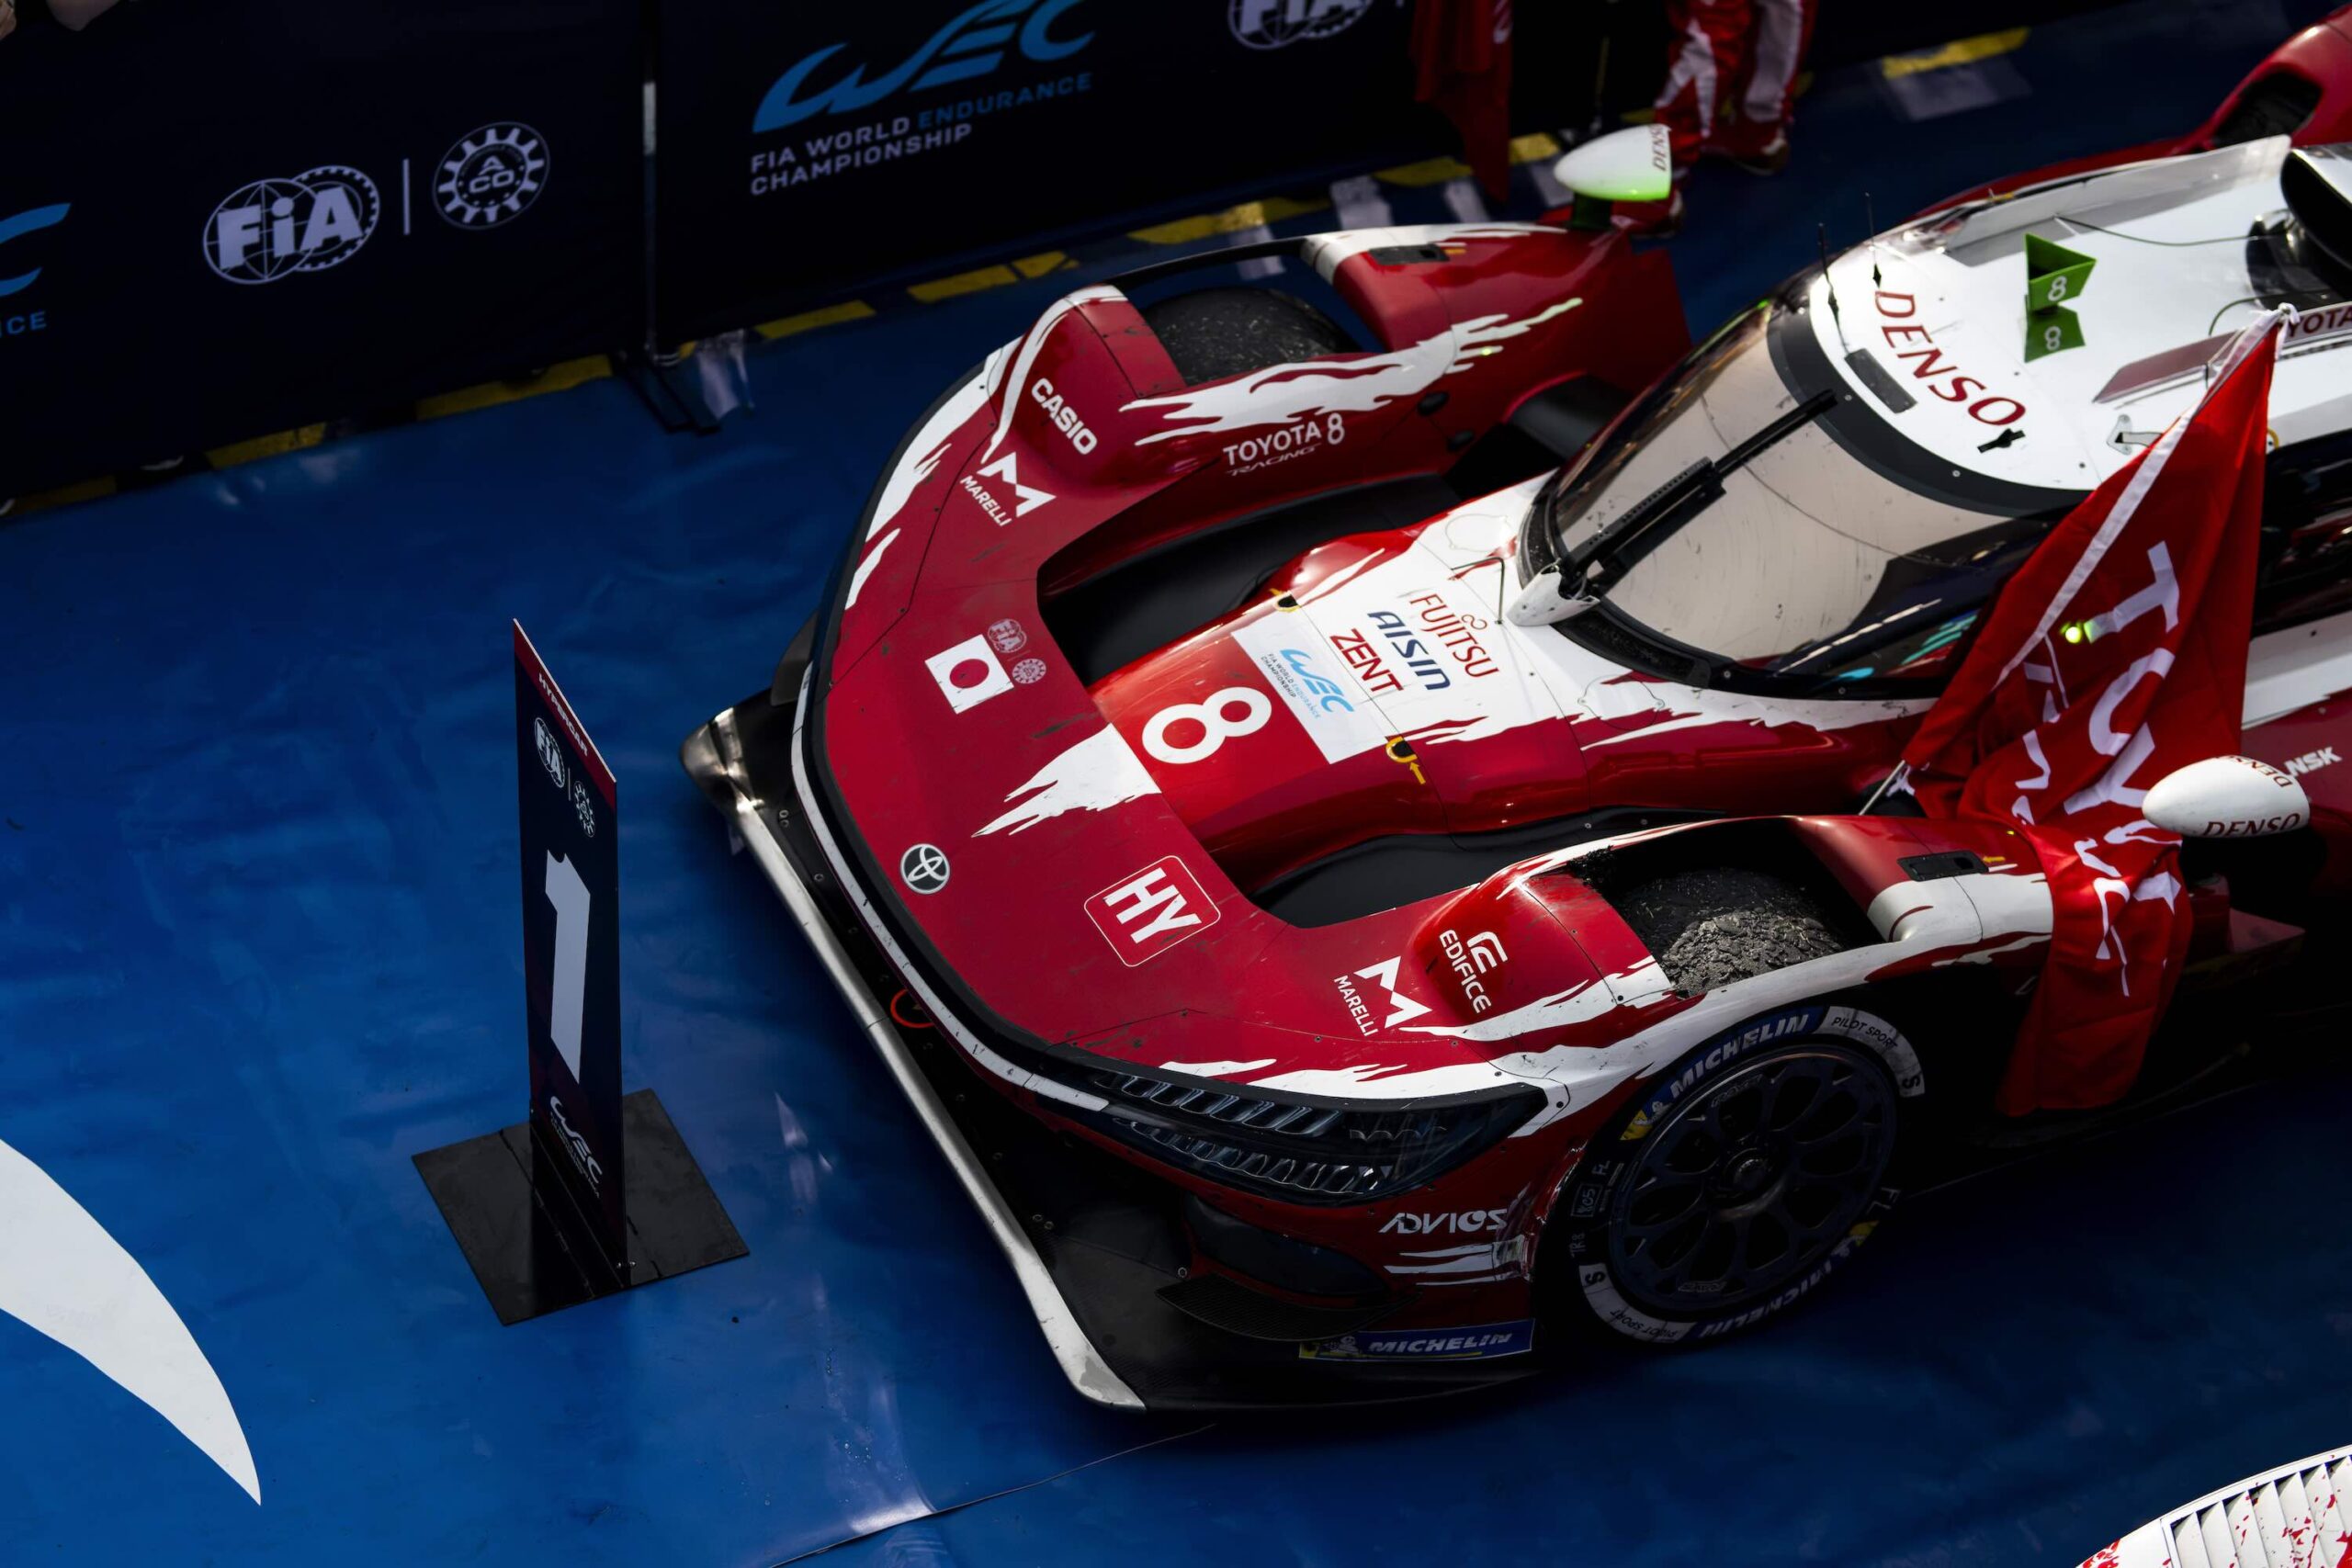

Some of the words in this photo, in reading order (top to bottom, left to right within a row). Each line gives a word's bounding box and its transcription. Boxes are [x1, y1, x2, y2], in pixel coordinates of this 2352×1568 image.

[750, 146, 797, 176] FIA
[806, 117, 911, 157] WORLD
[917, 71, 1094, 130] ENDURANCE
[750, 122, 974, 197] CHAMPIONSHIP
[2047, 276, 2067, 302] 8
[1874, 290, 2027, 426] DENSO
[1031, 378, 1098, 455] CASIO
[1222, 421, 1323, 466] TOYOTA
[1327, 412, 1346, 446] 8
[1225, 442, 1323, 477] RACING
[960, 475, 1012, 526] MARELLI
[1268, 653, 1281, 666] FIA
[1276, 661, 1295, 683] WORLD
[1329, 627, 1405, 692] ZENT
[1366, 611, 1451, 691] AISIN
[1408, 593, 1499, 678] FUJITSU
[1261, 656, 1296, 698] CHAMPIONSHIP
[1142, 686, 1272, 764] 8
[2284, 746, 2343, 778] NSK
[1103, 867, 1202, 944] HY
[545, 849, 591, 1084] 1
[1439, 929, 1492, 1014] EDIFICE
[1334, 975, 1379, 1037] MARELLI
[1670, 1012, 1810, 1100] MICHELIN
[1830, 1016, 1864, 1032] PILOT
[1865, 1025, 1900, 1049] SPORT
[1699, 1259, 1833, 1339] MICHELIN
[1368, 1333, 1514, 1355] MICHELIN
